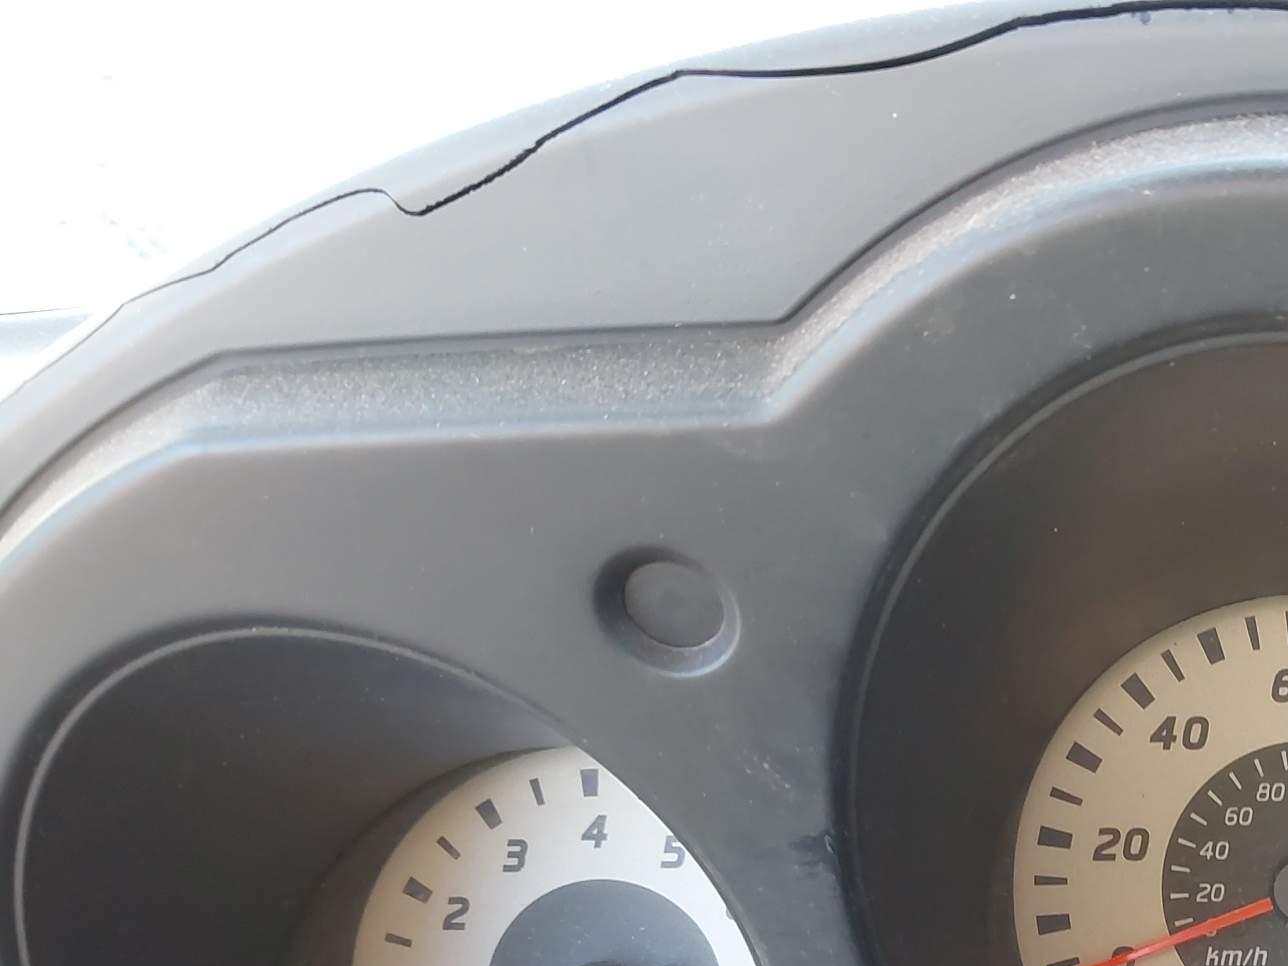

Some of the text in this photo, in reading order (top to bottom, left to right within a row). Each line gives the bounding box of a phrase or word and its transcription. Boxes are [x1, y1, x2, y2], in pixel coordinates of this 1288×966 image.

[1150, 716, 1210, 750] 40
[1256, 782, 1286, 802] 80
[581, 815, 609, 848] 4
[1224, 806, 1254, 826] 60
[502, 839, 529, 872] 3
[660, 835, 686, 869] 5
[1092, 827, 1150, 861] 20
[1200, 840, 1230, 861] 40
[1196, 883, 1225, 903] 20
[442, 896, 470, 930] 2
